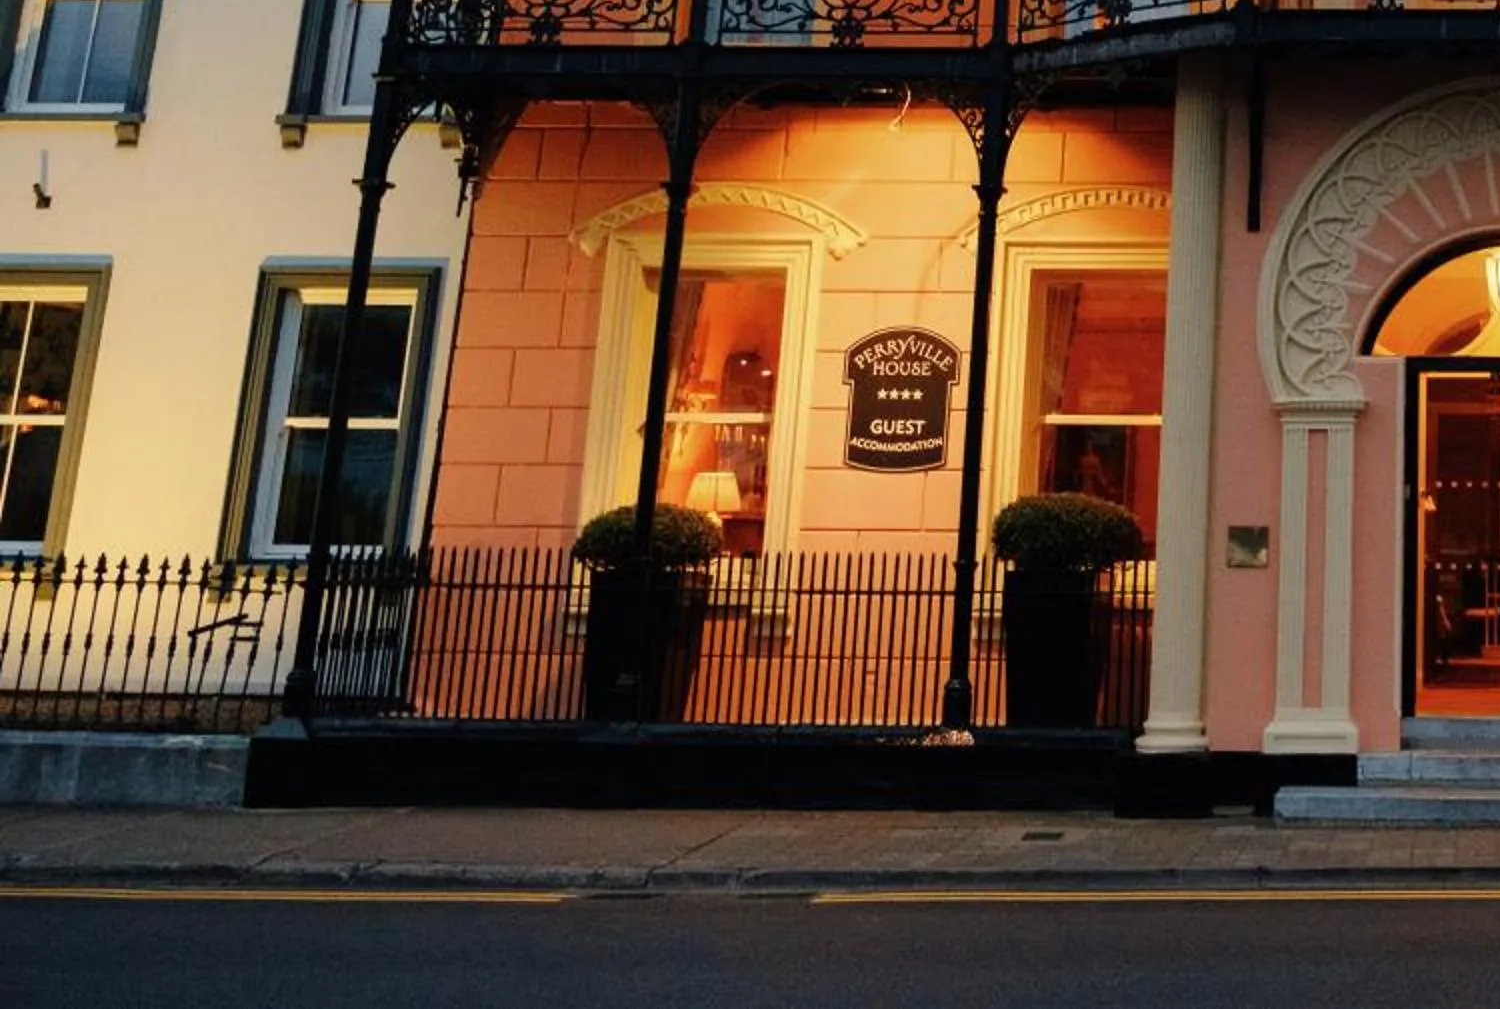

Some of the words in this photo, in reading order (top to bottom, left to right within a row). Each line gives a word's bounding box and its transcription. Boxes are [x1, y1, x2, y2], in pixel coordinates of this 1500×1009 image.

[854, 334, 953, 371] PERRYVILLE
[873, 360, 932, 376] HOUSE
[869, 419, 926, 434] GUEST
[849, 436, 943, 452] ACCOMMODATION
